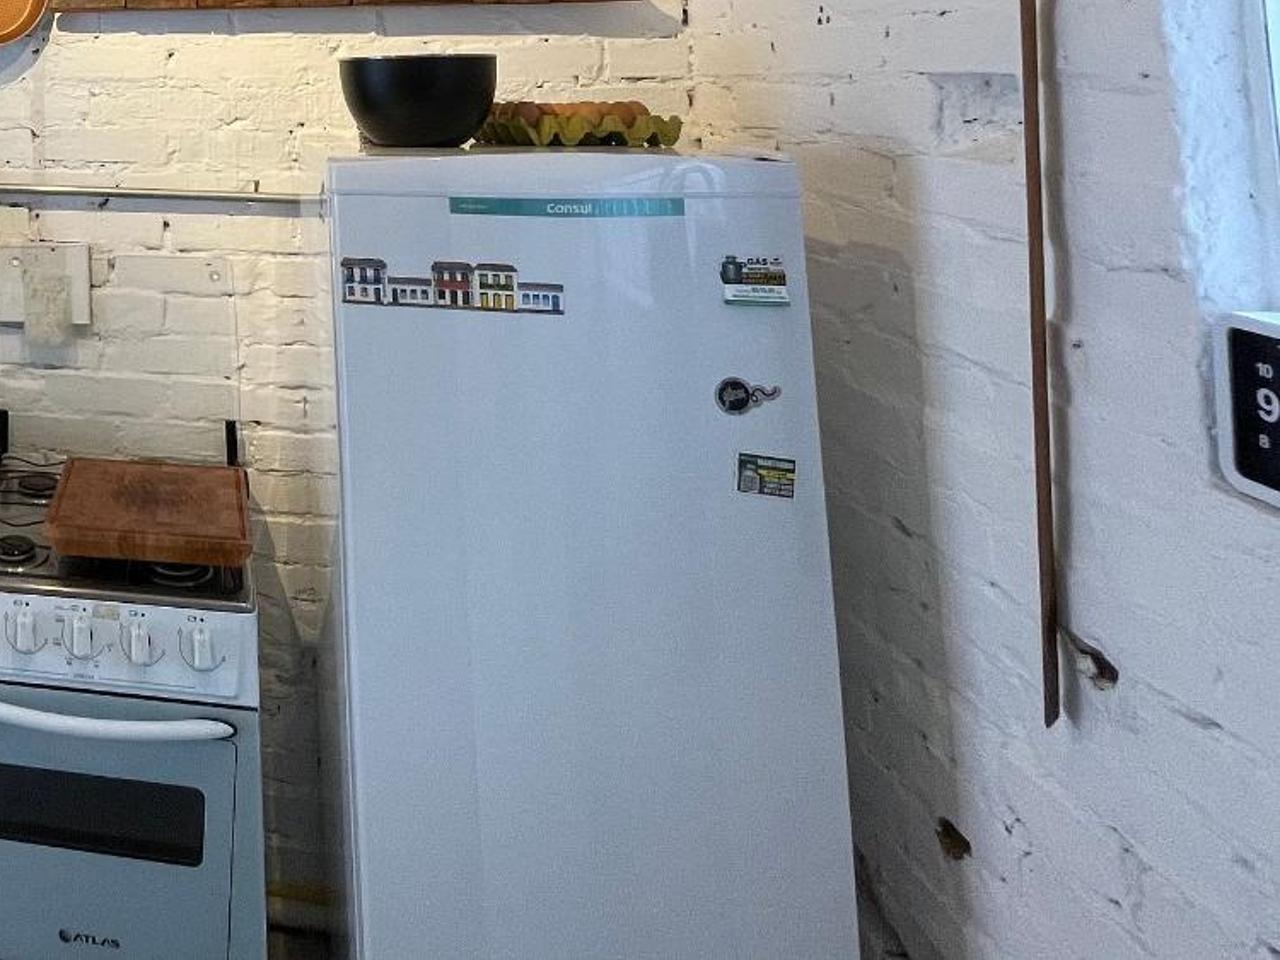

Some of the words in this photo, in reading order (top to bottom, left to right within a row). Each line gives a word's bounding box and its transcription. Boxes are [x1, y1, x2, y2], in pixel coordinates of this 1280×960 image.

[547, 203, 592, 214] Consul
[1256, 362, 1273, 379] 10
[1256, 387, 1280, 423] 9
[73, 933, 120, 949] ATLAS
